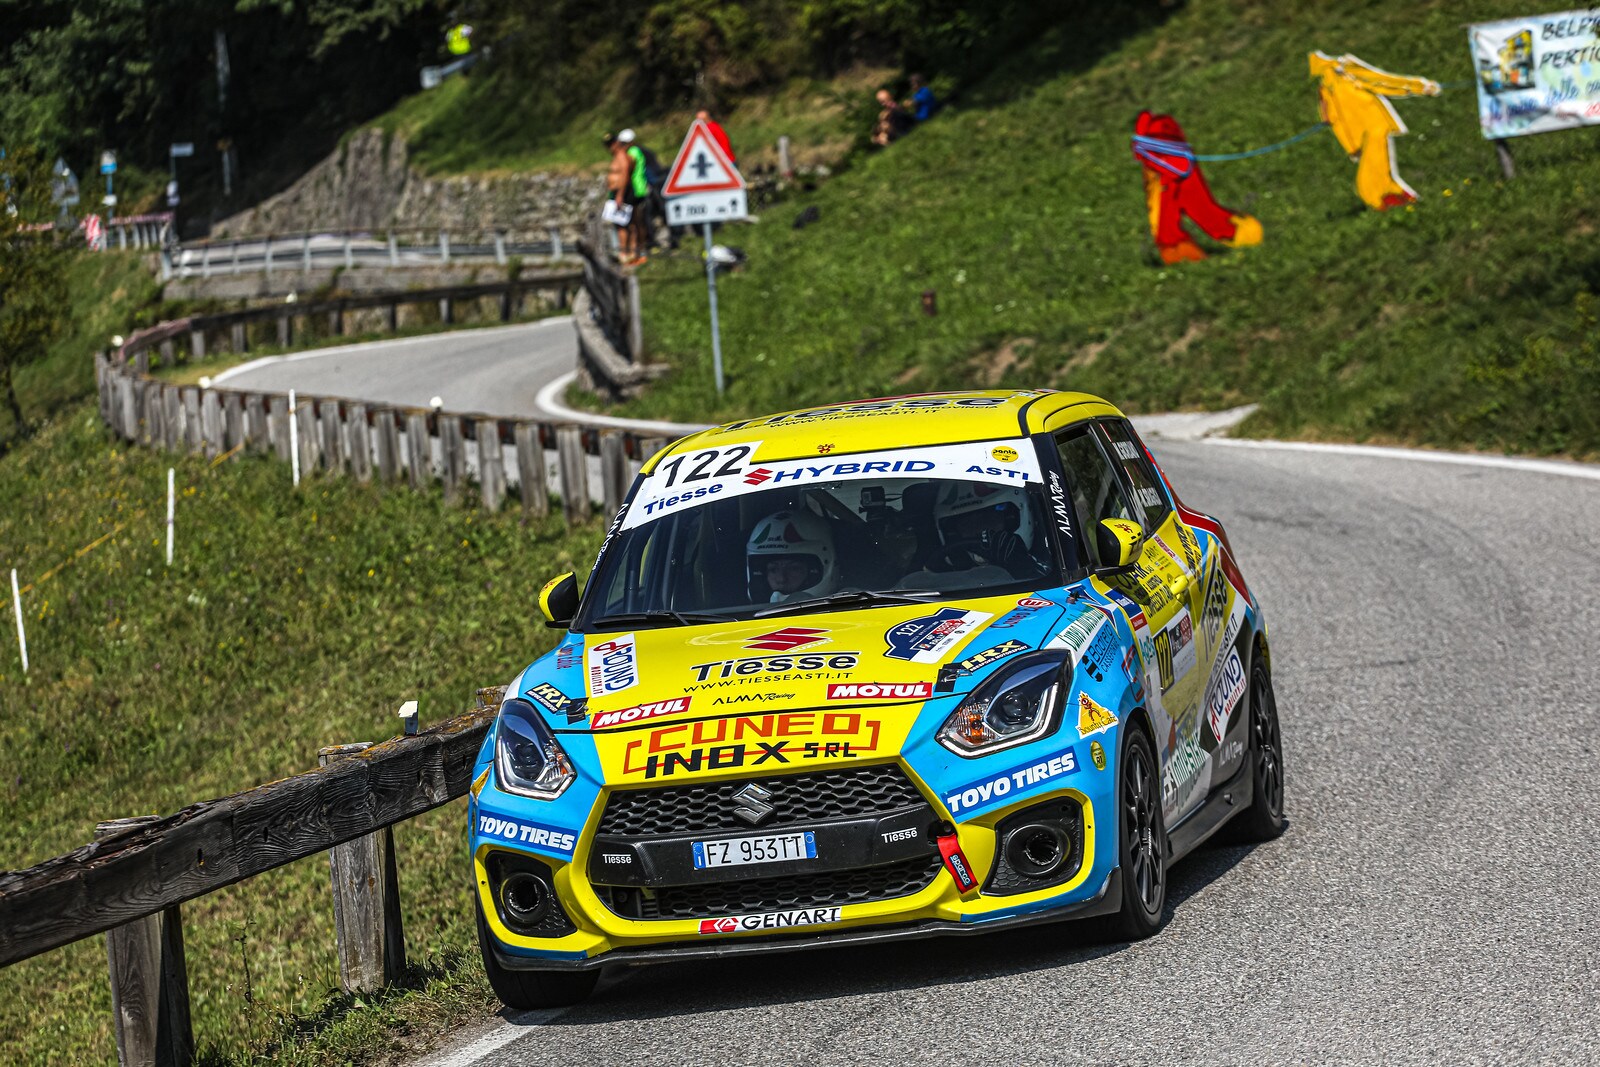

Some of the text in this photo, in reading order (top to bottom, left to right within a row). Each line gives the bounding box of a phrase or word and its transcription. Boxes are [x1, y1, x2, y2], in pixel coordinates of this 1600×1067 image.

[663, 446, 751, 488] 122
[773, 460, 936, 483] HYBRID
[965, 465, 1029, 480] ASTI
[643, 483, 723, 515] Tiesse
[896, 623, 924, 637] 122
[593, 641, 635, 692] AROUND
[691, 652, 860, 682] Tiesse
[962, 641, 1020, 669] HRX
[1156, 630, 1174, 690] 122
[532, 683, 572, 709] HRX
[683, 672, 853, 693] WWW.TIESSEASTI.IT
[830, 684, 929, 698] MOTUL
[595, 698, 685, 726] MOTUL
[712, 692, 796, 706] ALMA Racing
[648, 713, 861, 753] CUNEO
[645, 741, 858, 779] INOX SRL
[947, 753, 1076, 812] TOYO TIRES
[479, 816, 576, 850] TOYO TIRES
[881, 827, 918, 844] Tiesse
[602, 854, 632, 864] Tiesse
[706, 842, 731, 865] FZ
[740, 835, 802, 862] 953TT
[952, 854, 971, 884] sparco
[741, 907, 841, 930] GENART
